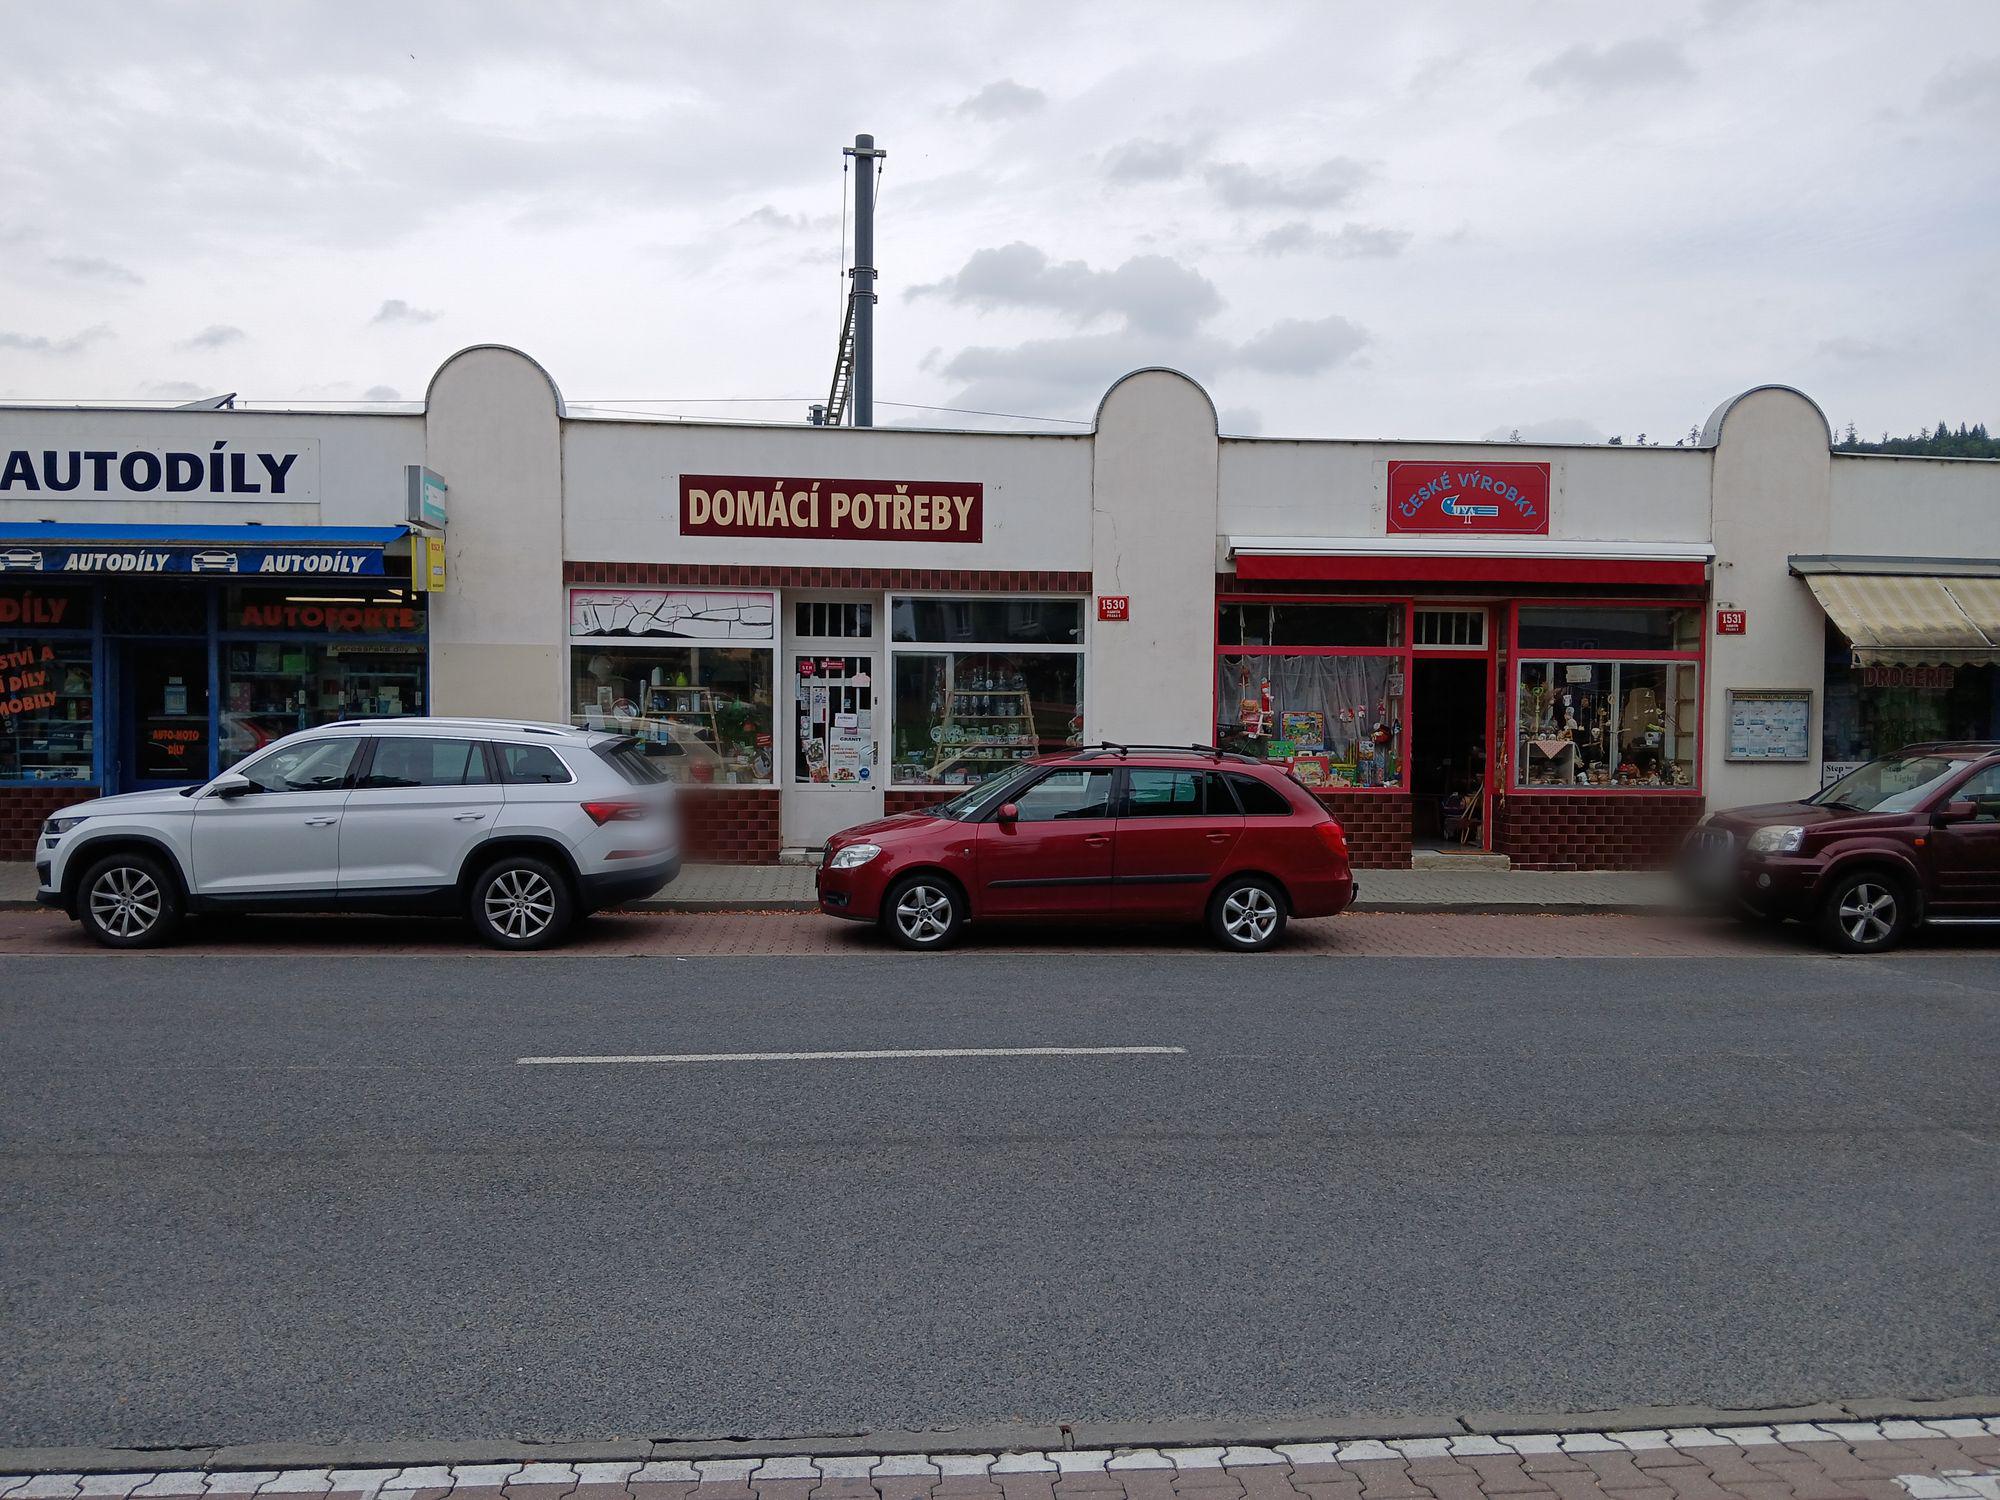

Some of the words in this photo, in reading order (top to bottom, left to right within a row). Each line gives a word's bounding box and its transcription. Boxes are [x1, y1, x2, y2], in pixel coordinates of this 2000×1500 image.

[0, 440, 299, 494] AUTODÍLY
[1398, 470, 1452, 517] ČESKÉ
[1457, 470, 1537, 518] VÝROBKY
[688, 481, 821, 528] DOMÁCÍ
[830, 484, 975, 532] POTŘEBY
[64, 550, 170, 572] AUTODÍLY
[259, 551, 367, 574] AUTODÍLY
[1102, 599, 1125, 610] 1530
[1722, 613, 1742, 624] 1531
[41, 646, 55, 661] A
[9, 670, 46, 692] DÍLY
[1863, 666, 1955, 688] DROGERIE
[153, 729, 199, 740] AUTO-MOTO
[168, 742, 184, 755] DÍLY
[1825, 764, 1844, 773] Step
